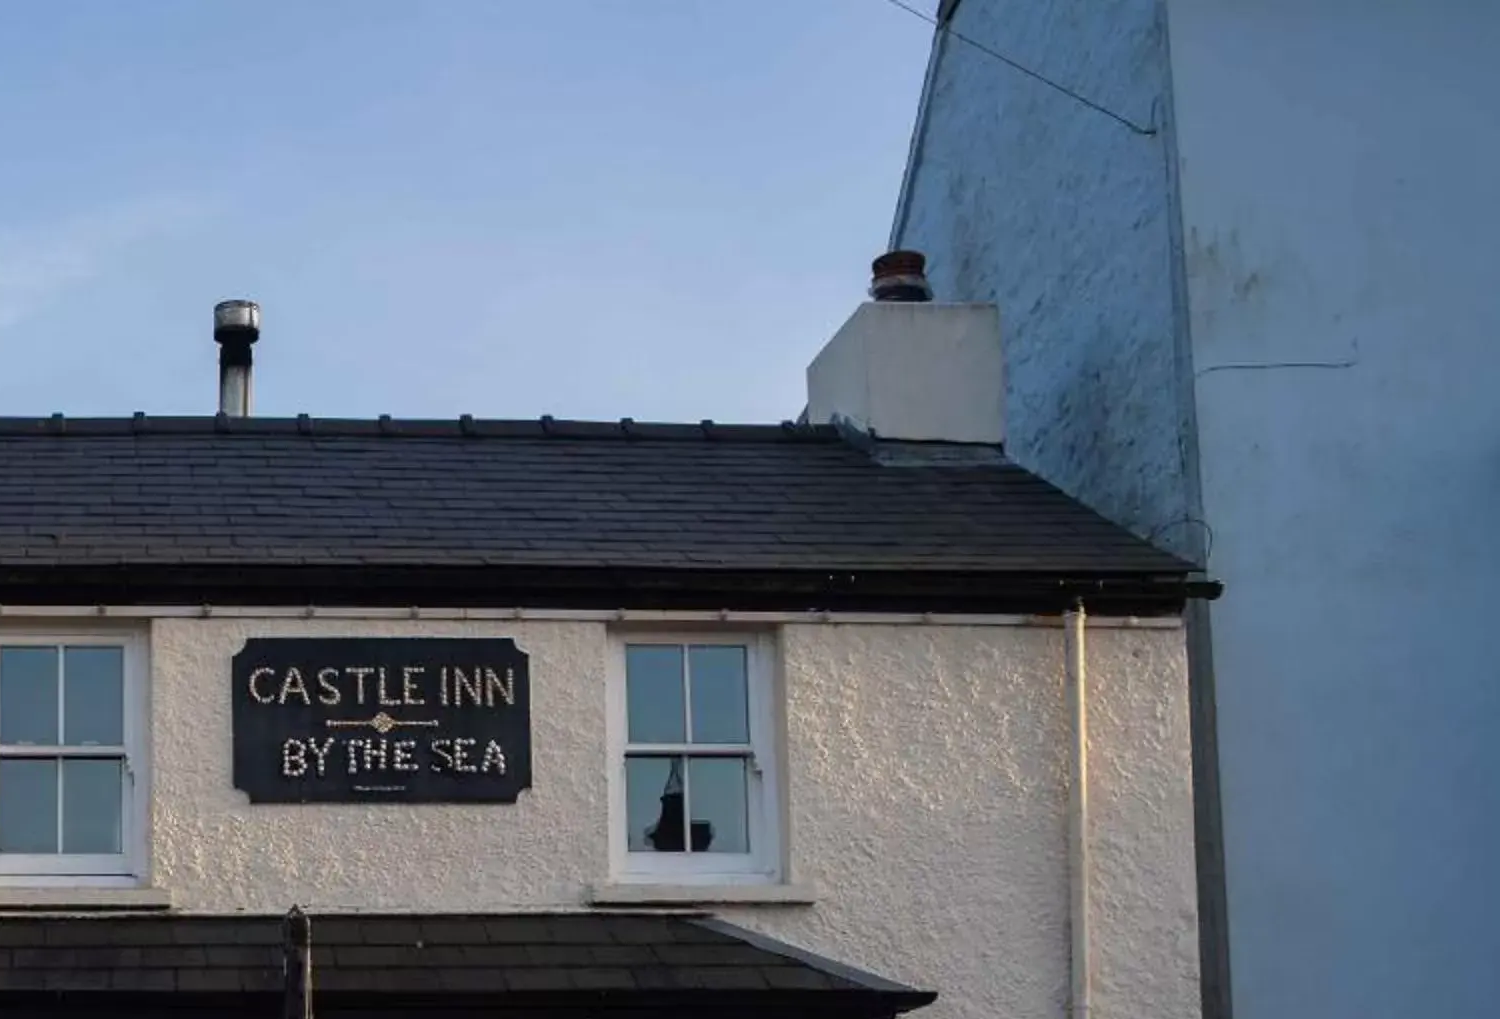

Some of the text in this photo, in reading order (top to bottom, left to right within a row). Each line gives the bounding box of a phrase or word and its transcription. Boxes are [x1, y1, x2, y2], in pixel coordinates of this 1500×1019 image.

[250, 666, 514, 706] CASTLE INN
[282, 737, 507, 777] BY THE SEA
